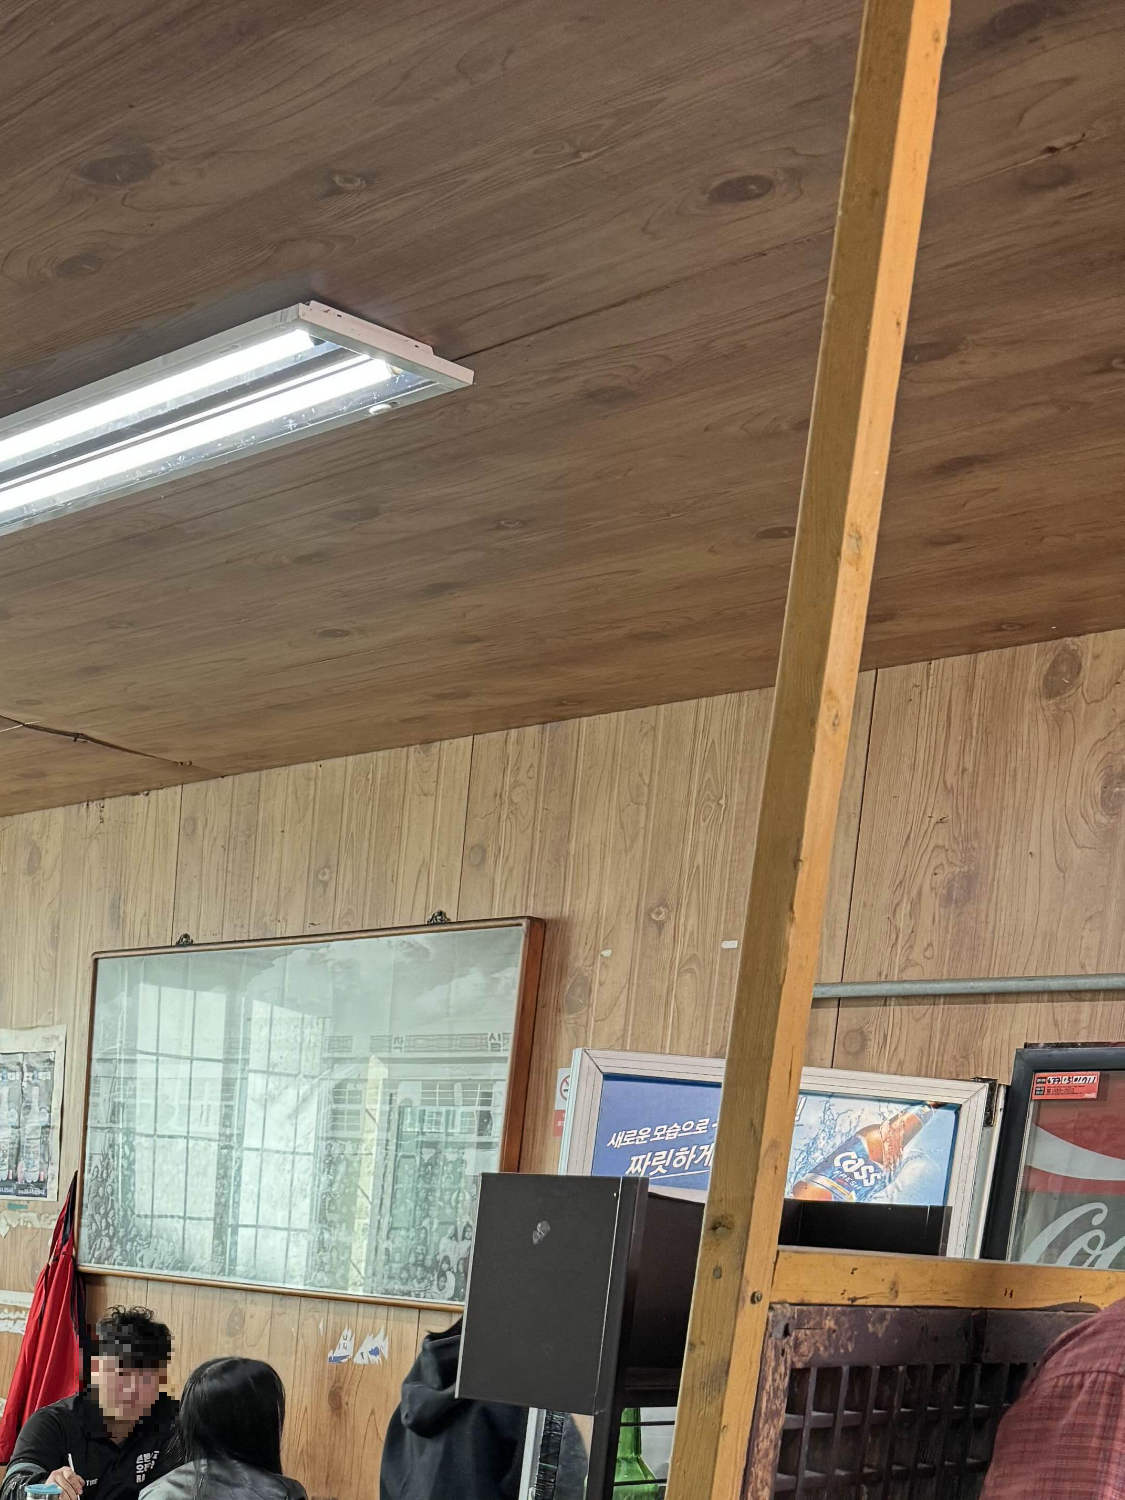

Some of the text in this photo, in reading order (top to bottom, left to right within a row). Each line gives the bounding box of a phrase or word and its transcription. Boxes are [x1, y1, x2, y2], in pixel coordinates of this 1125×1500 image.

[607, 1127, 650, 1149] 새로운
[650, 1118, 710, 1142] 모습으로
[625, 1142, 715, 1177] 짜릿하게
